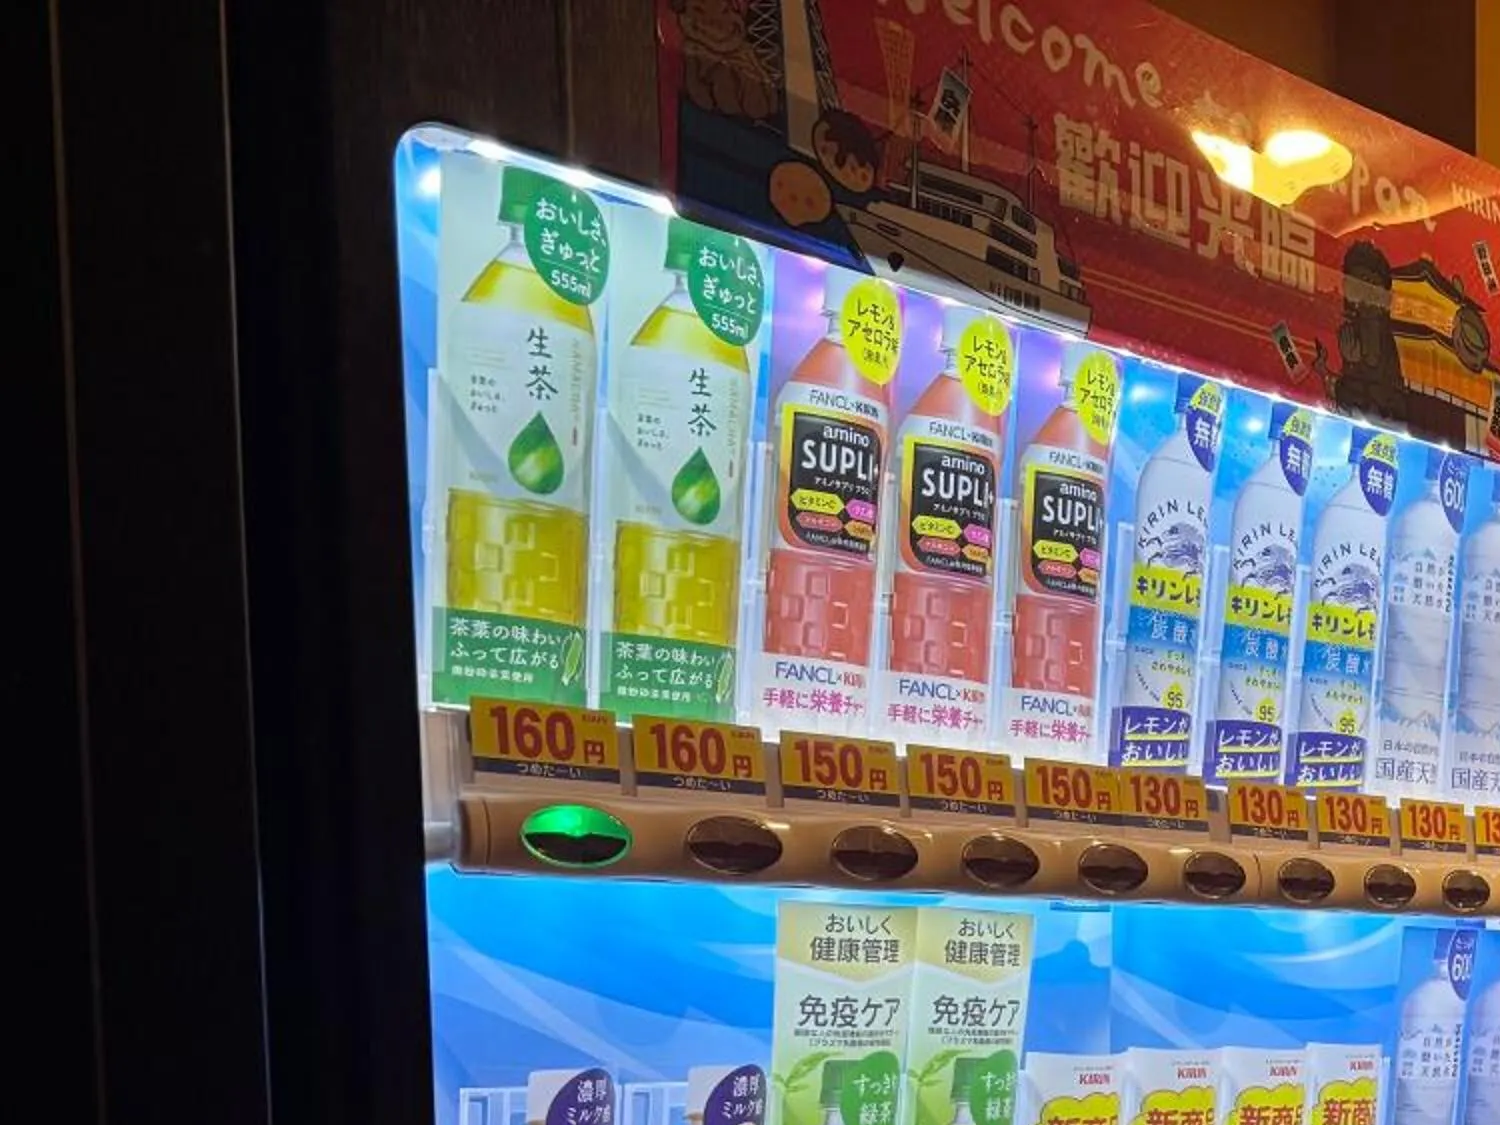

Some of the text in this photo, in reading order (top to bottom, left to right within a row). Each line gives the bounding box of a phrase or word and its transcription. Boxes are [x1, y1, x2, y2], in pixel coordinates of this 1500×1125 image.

[540, 230, 601, 274] ぎゅっと
[703, 276, 757, 315] ぎゅっと
[525, 327, 559, 401] 生茶
[687, 368, 717, 437] 生茶
[823, 424, 871, 448] amino
[941, 453, 987, 477] amino
[825, 913, 892, 935] おいしく
[958, 918, 1015, 938] おいしく
[810, 936, 900, 964] 健康管理
[944, 941, 1021, 967] 健康管理
[798, 994, 900, 1029] 免疫ケア
[932, 995, 1020, 1027] 免疫ケア
